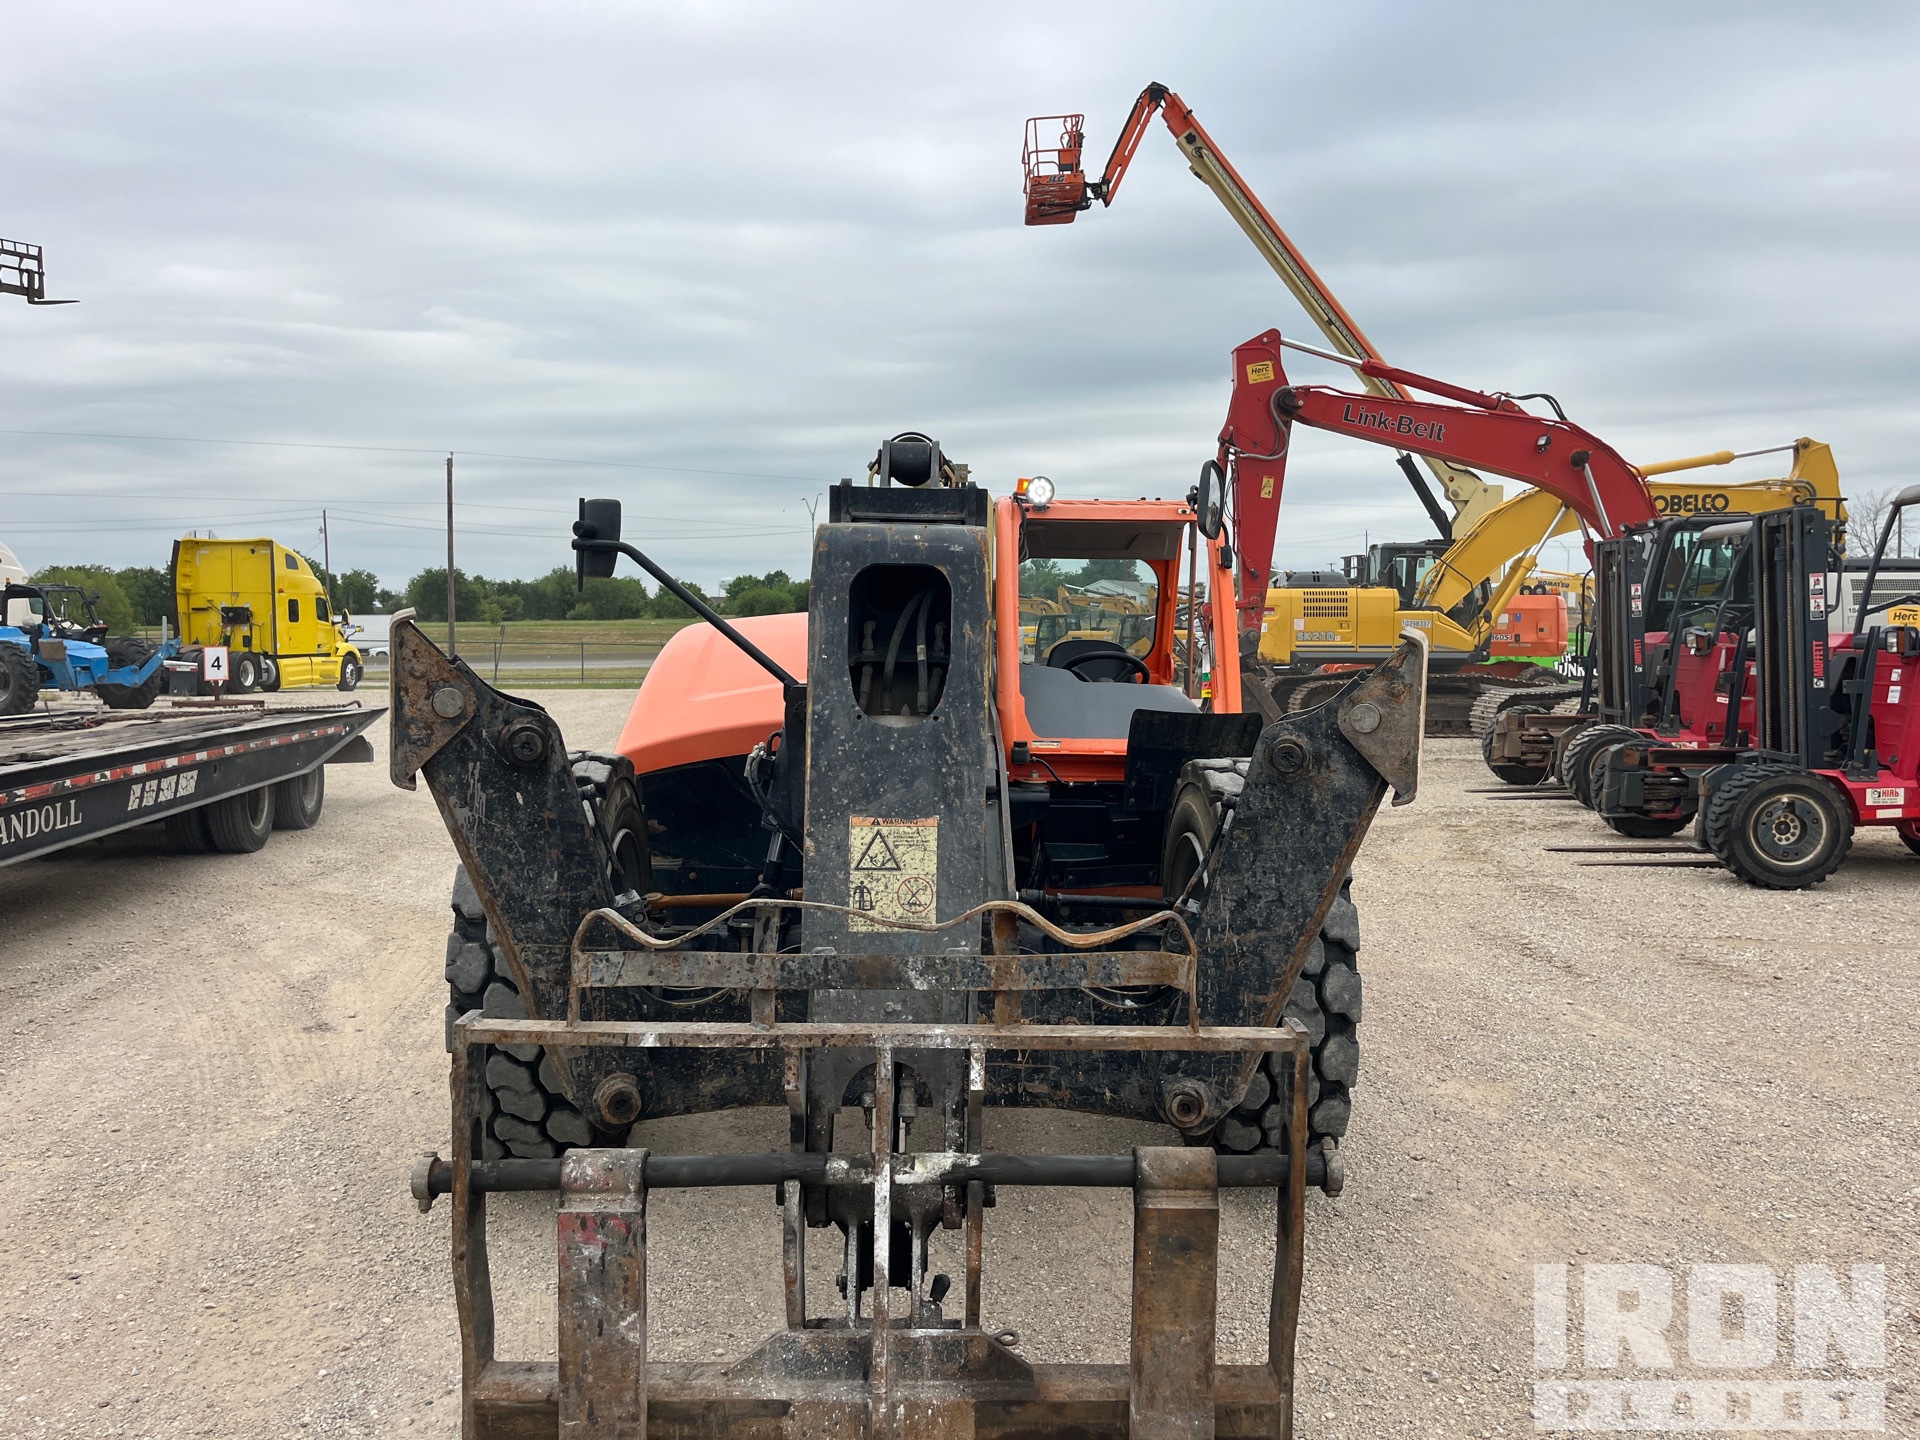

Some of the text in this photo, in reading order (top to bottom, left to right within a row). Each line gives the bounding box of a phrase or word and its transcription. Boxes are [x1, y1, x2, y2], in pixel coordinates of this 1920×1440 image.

[1251, 365, 1269, 375] Herc
[1342, 403, 1446, 443] Link-Belt
[1653, 493, 1729, 513] OBELCO
[1538, 580, 1570, 588] KOMATSU
[1893, 612, 1918, 621] Herc
[211, 656, 222, 671] 4
[1813, 640, 1824, 677] MOFFETT
[0, 799, 82, 845] ANDOLL
